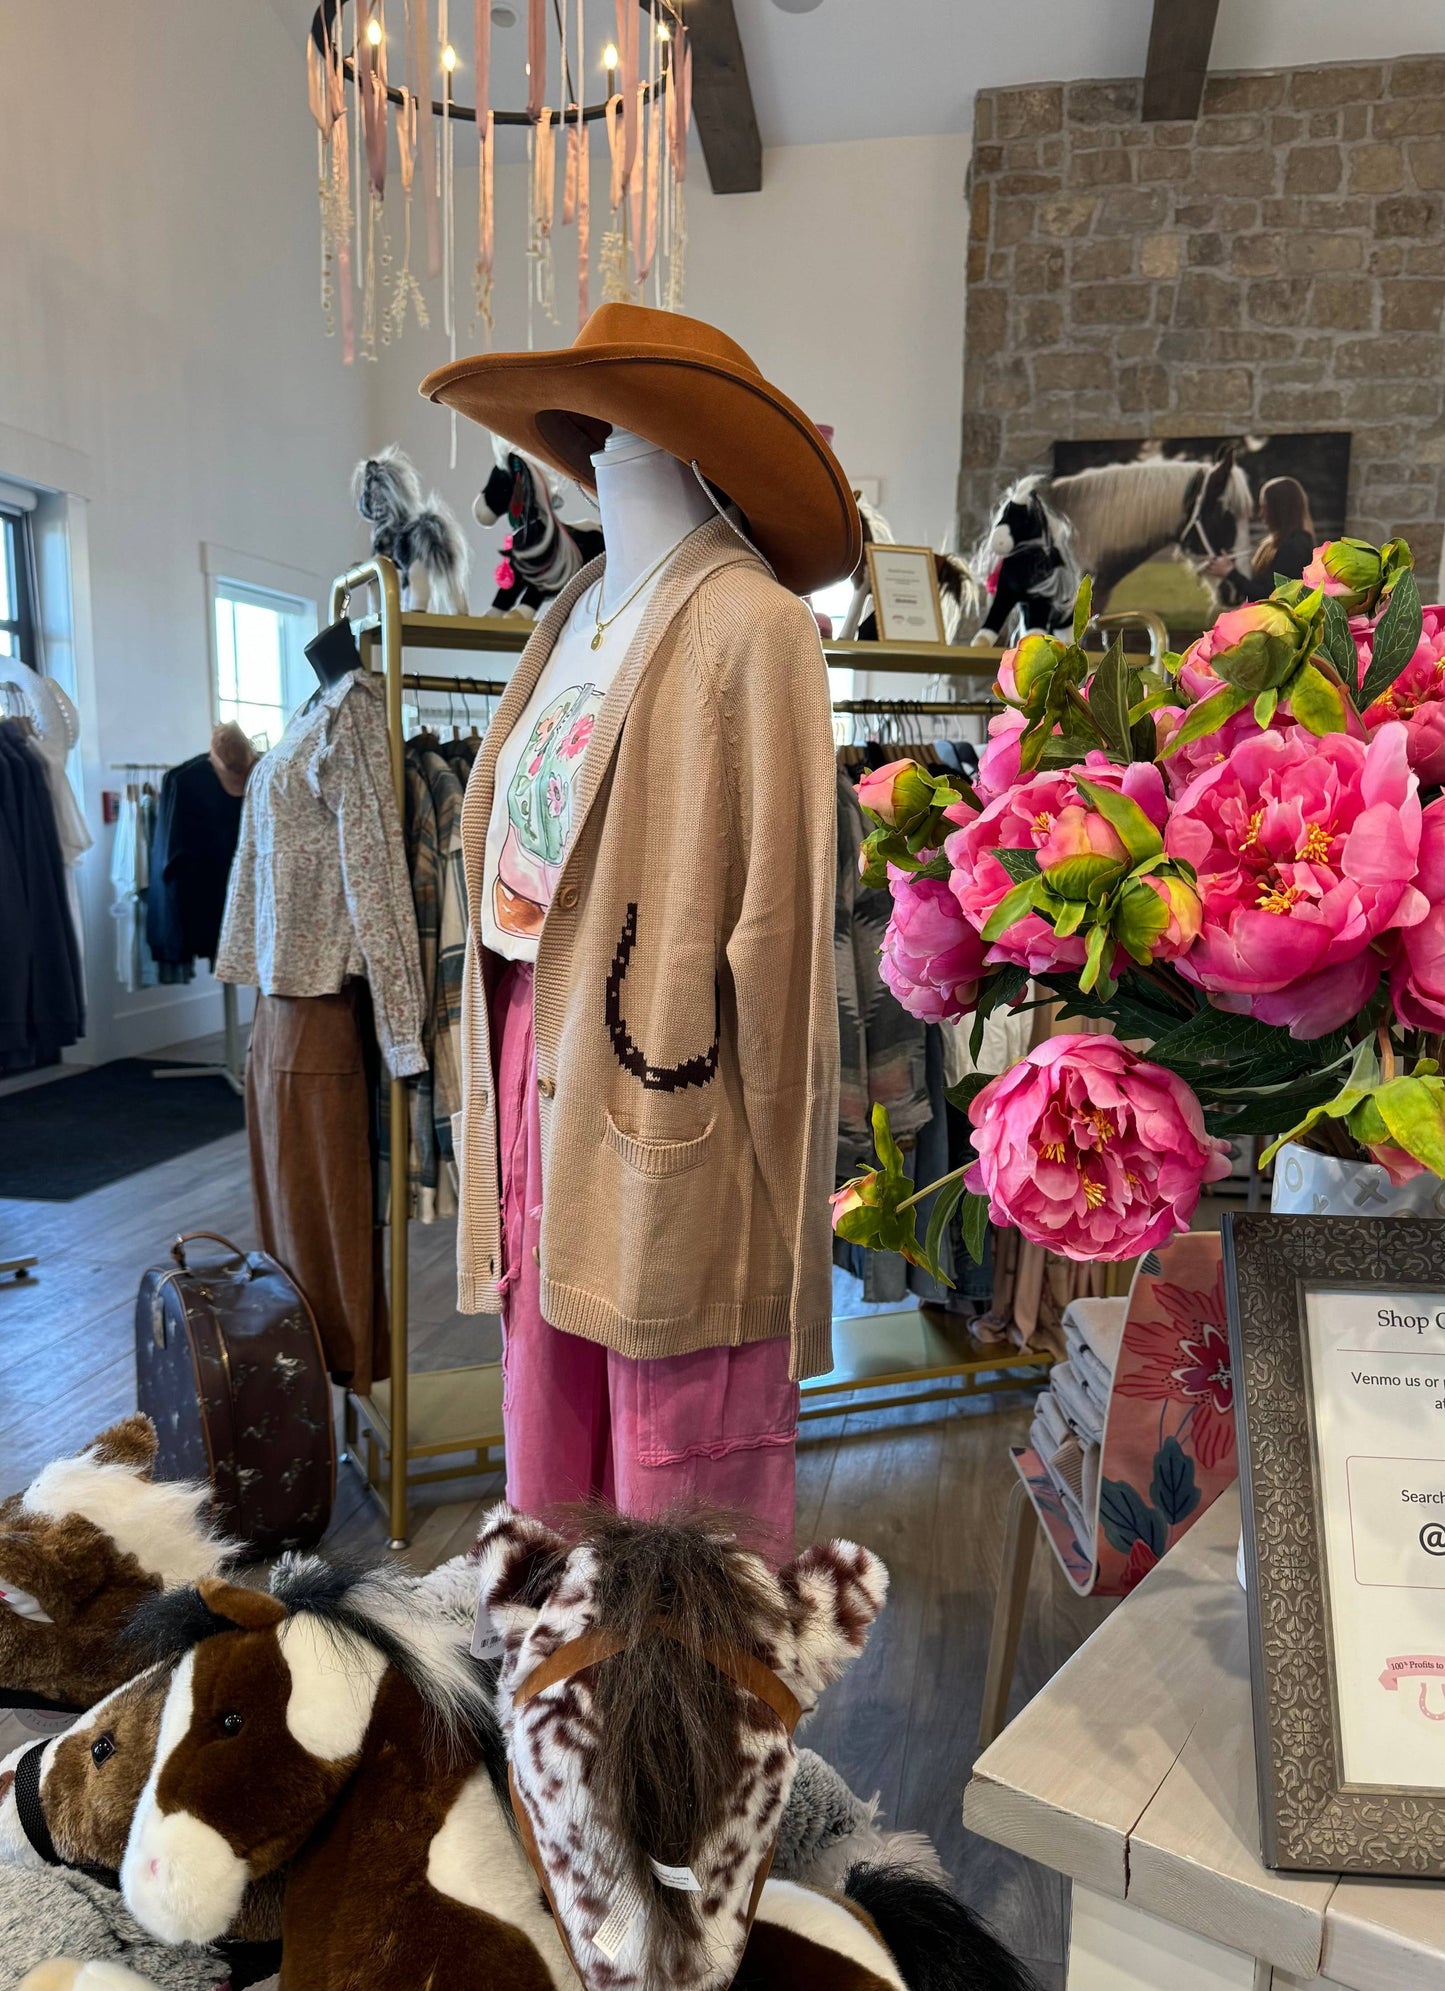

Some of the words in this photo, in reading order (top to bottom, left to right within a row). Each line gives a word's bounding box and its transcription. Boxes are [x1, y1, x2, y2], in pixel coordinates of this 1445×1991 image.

[1377, 1309, 1430, 1335] Shop
[1351, 1371, 1401, 1386] Venmo
[1405, 1377, 1421, 1387] us
[1425, 1378, 1440, 1388] or
[1401, 1489, 1445, 1504] Search
[1409, 1660, 1435, 1669] Profits
[1436, 1662, 1444, 1670] to
